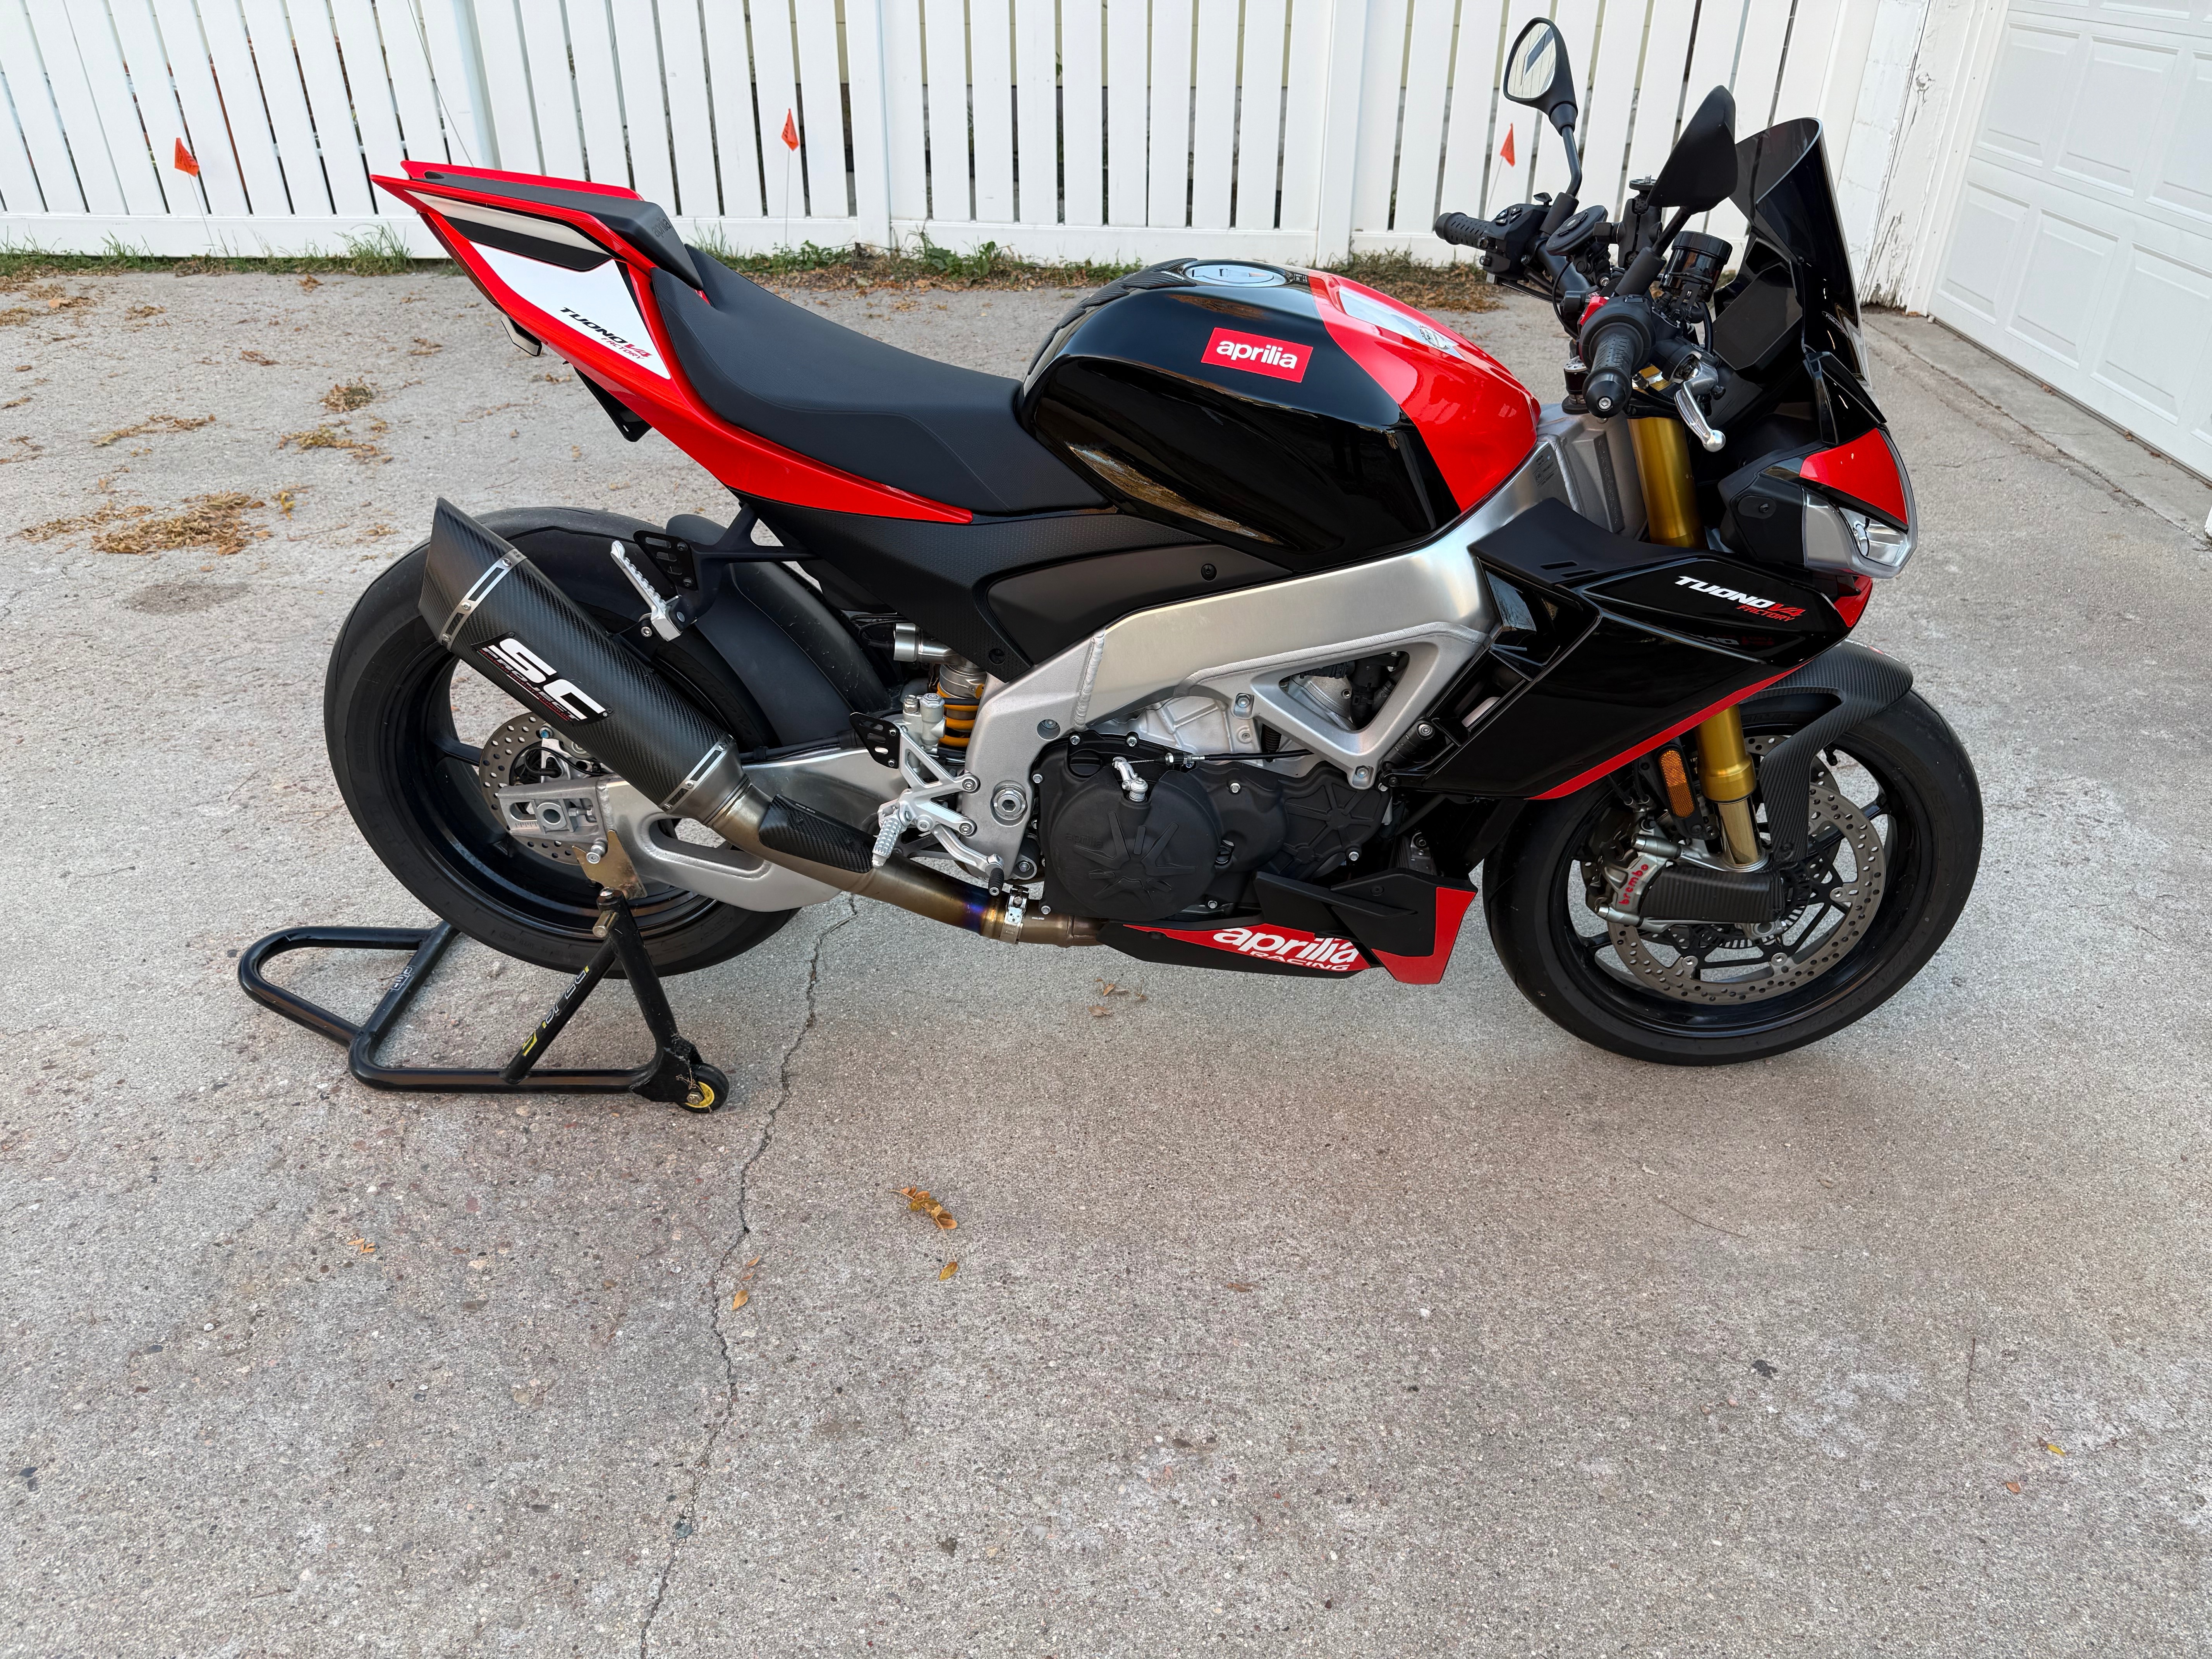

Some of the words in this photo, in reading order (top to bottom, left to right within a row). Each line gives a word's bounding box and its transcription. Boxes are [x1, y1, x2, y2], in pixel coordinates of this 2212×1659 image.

[651, 217, 672, 238] aprilia
[560, 307, 628, 343] TUONO
[601, 338, 644, 359] FACTORY
[1216, 341, 1298, 369] aprilia
[1675, 576, 1776, 608] TUONO
[1736, 605, 1795, 622] FACTORY
[481, 647, 580, 721] PROJECT
[1619, 864, 1649, 905] brembo
[1212, 927, 1360, 964] aprilia
[1249, 951, 1350, 971] RACING
